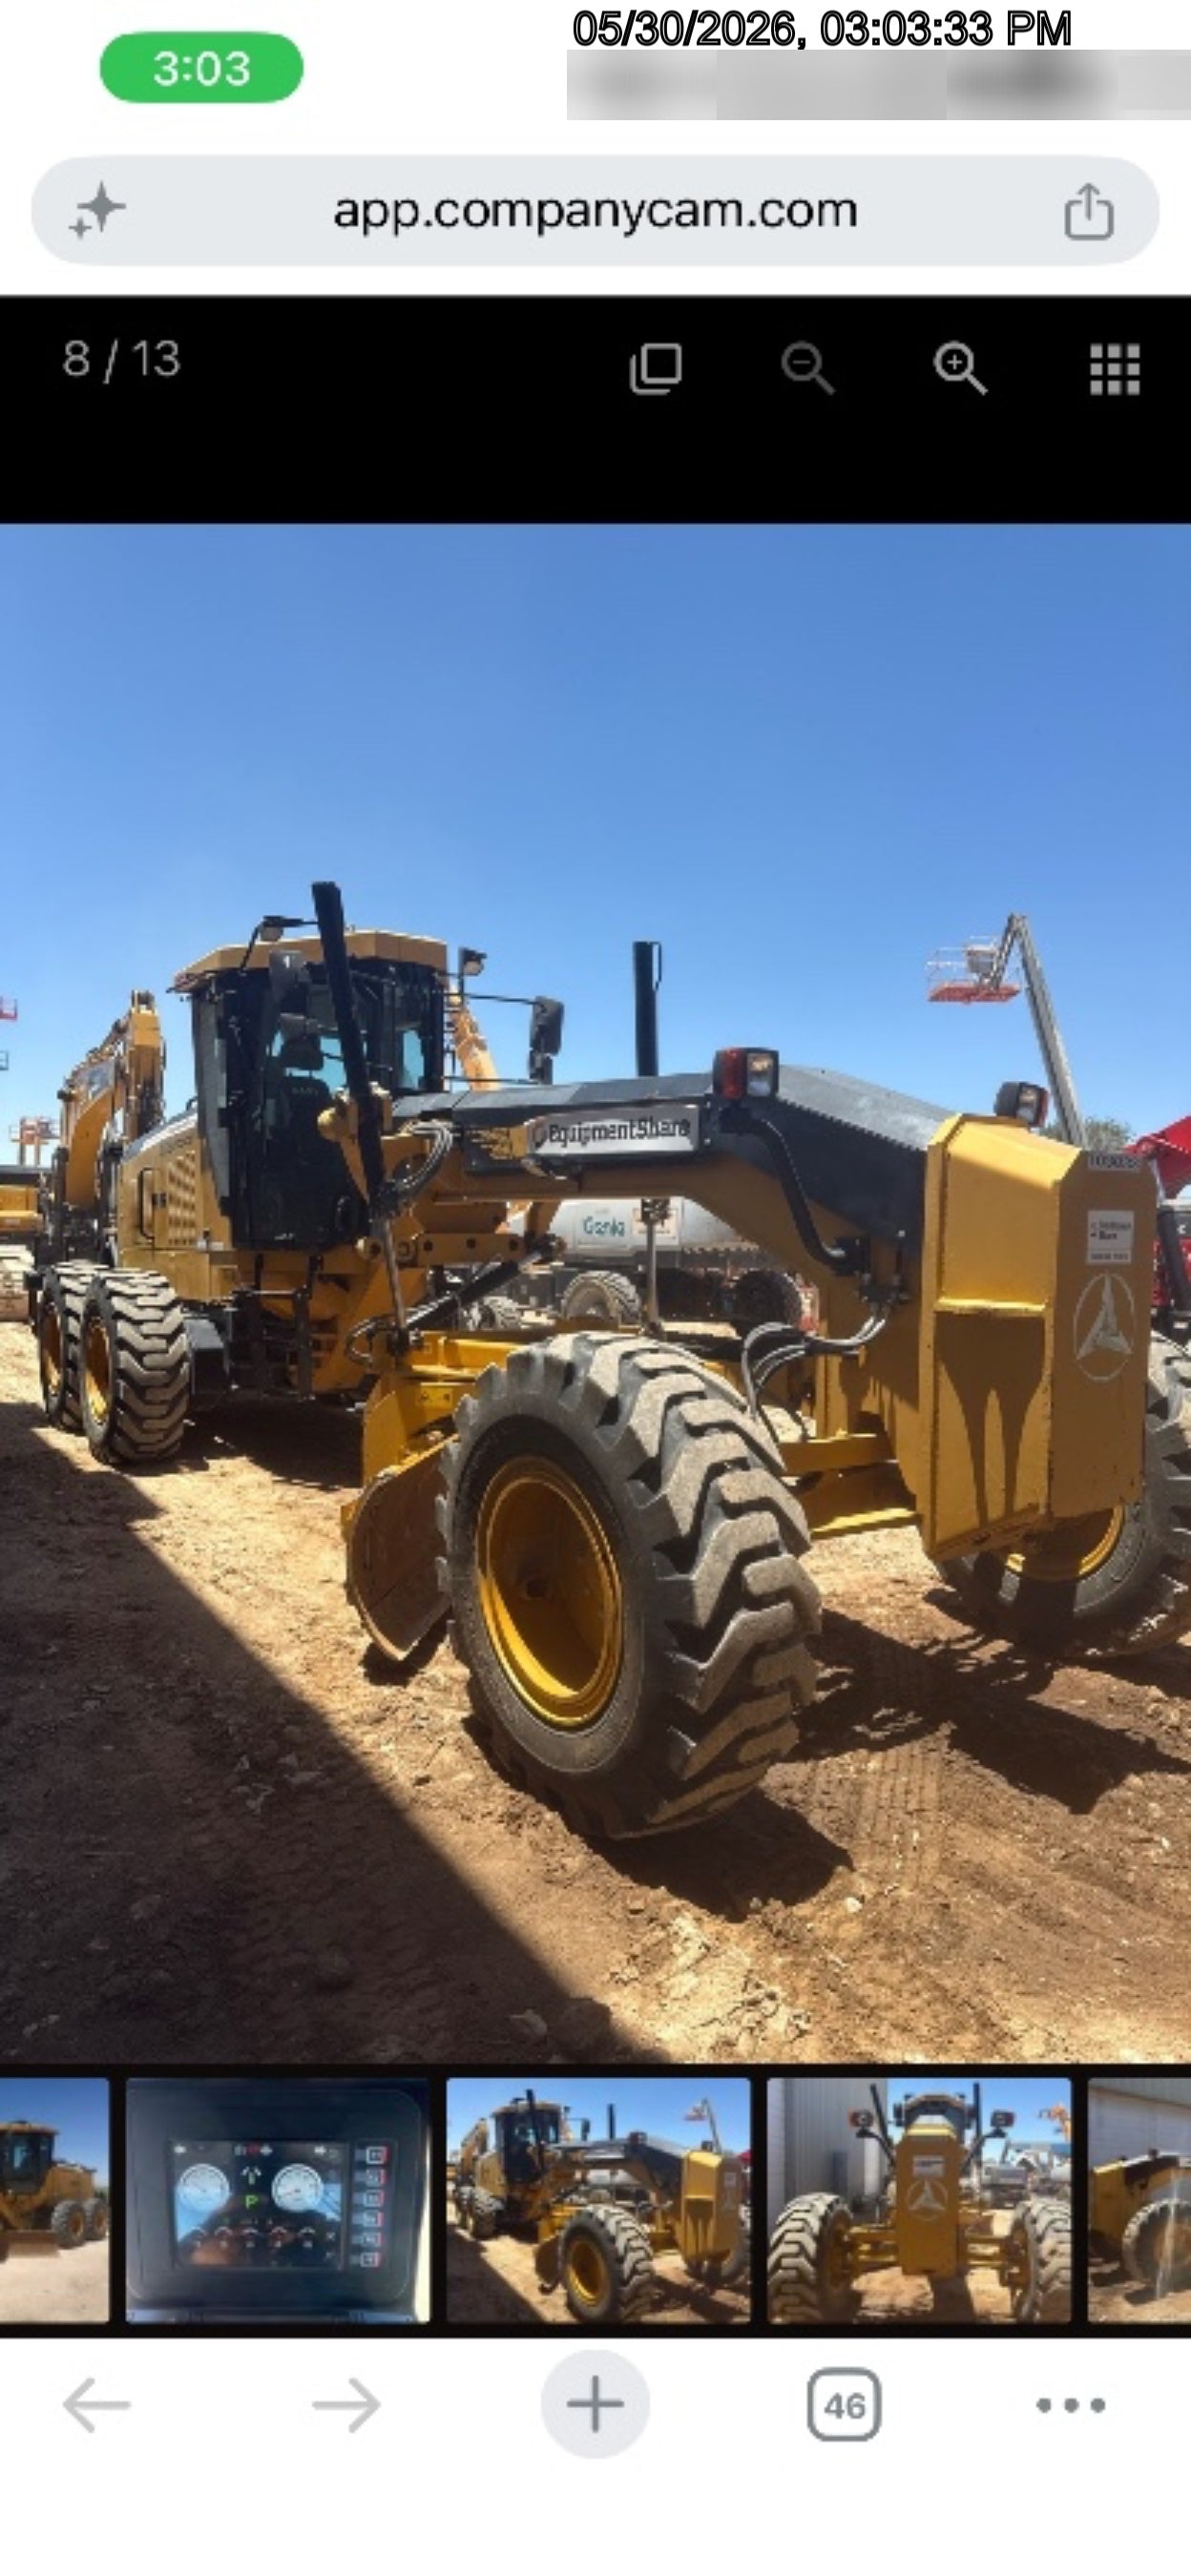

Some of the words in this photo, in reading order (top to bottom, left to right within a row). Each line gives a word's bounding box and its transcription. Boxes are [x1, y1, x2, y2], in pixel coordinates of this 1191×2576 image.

[153, 50, 250, 87] 3:03
[334, 196, 857, 238] app.companycam.com
[62, 339, 90, 378] 8
[134, 339, 181, 378] 13
[549, 1115, 691, 1148] EquipmentShare
[824, 2392, 867, 2420] 46
